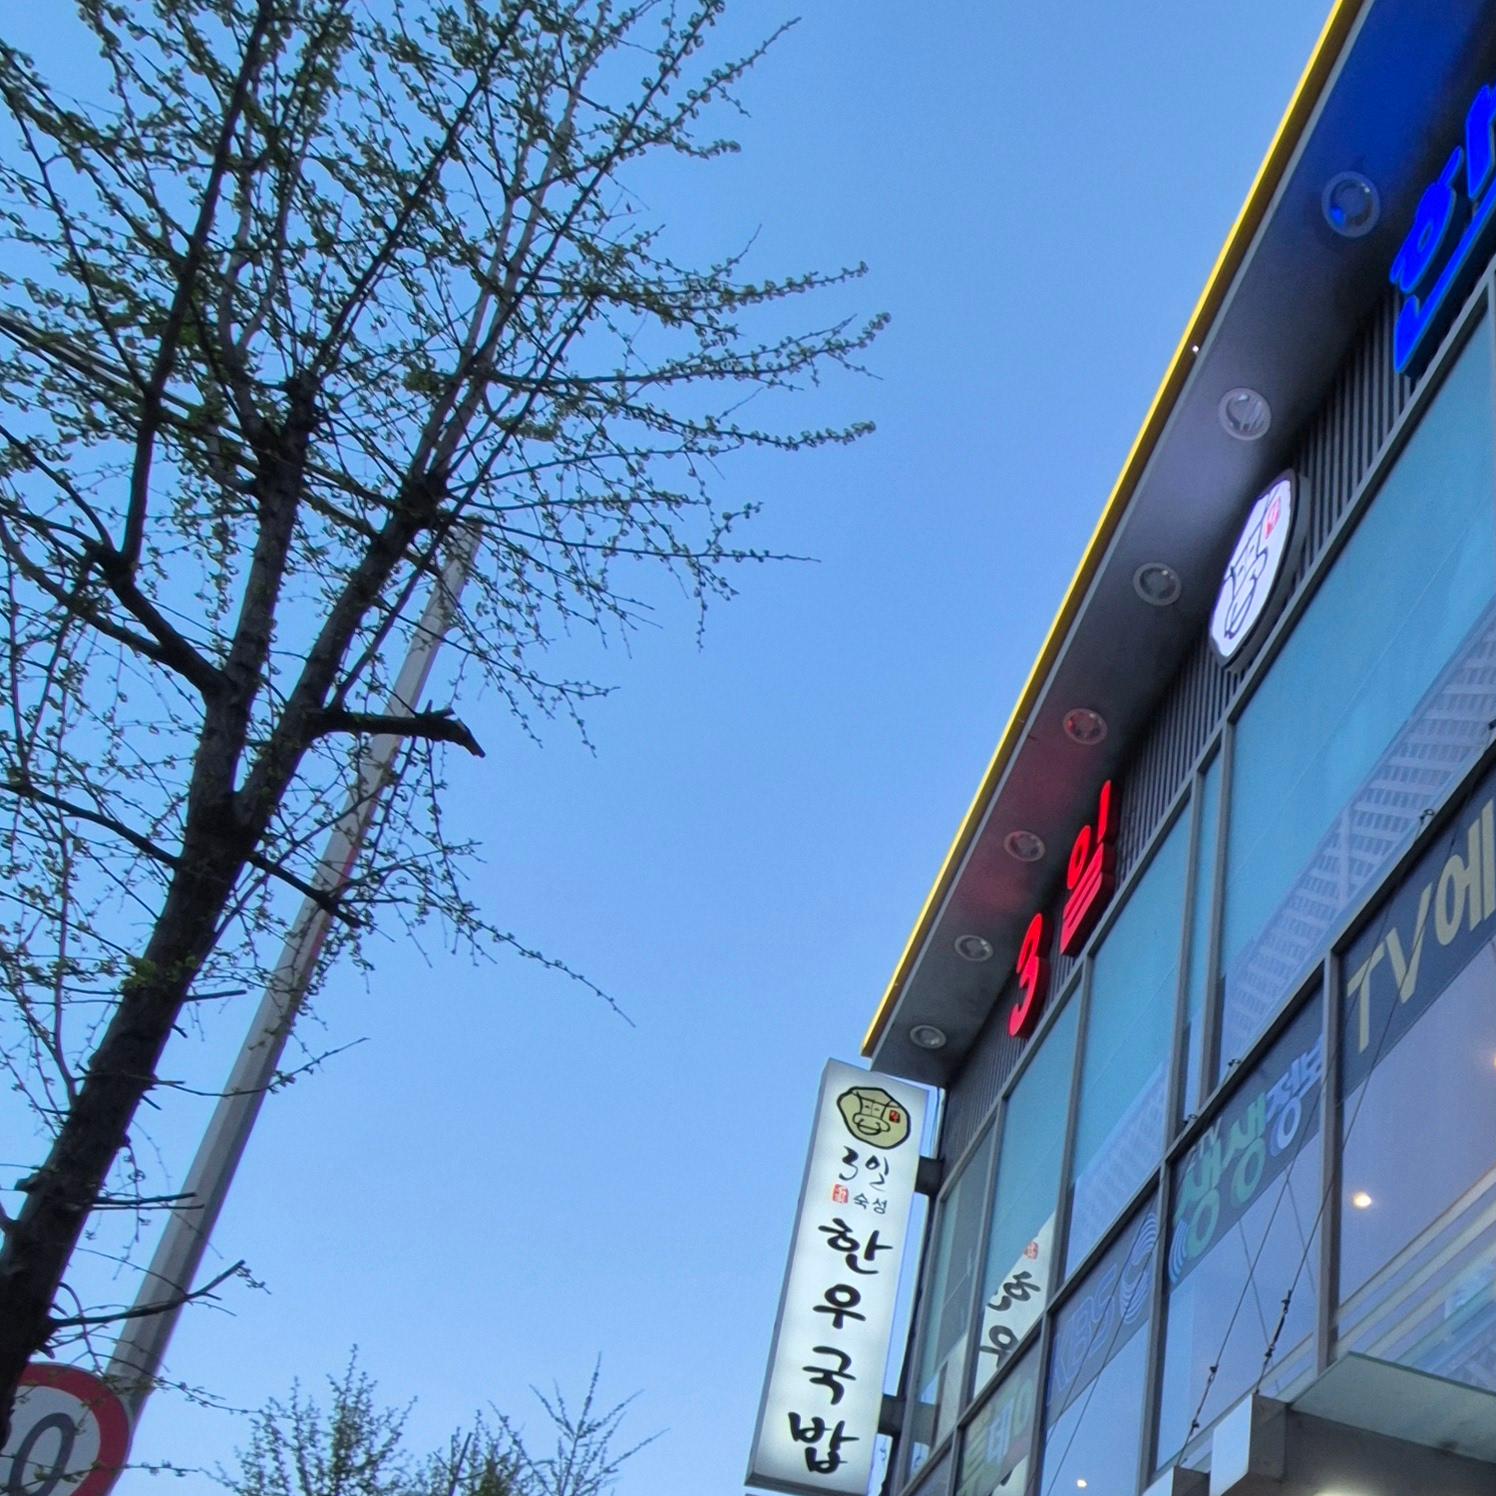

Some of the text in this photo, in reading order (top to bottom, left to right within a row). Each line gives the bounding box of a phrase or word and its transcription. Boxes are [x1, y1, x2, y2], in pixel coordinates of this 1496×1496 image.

[1008, 780, 1115, 1038] 3일
[839, 1145, 889, 1192] 3일
[853, 1193, 888, 1215] 숙성
[786, 1217, 893, 1475] 한우국밥
[1051, 1262, 1118, 1393] KBS
